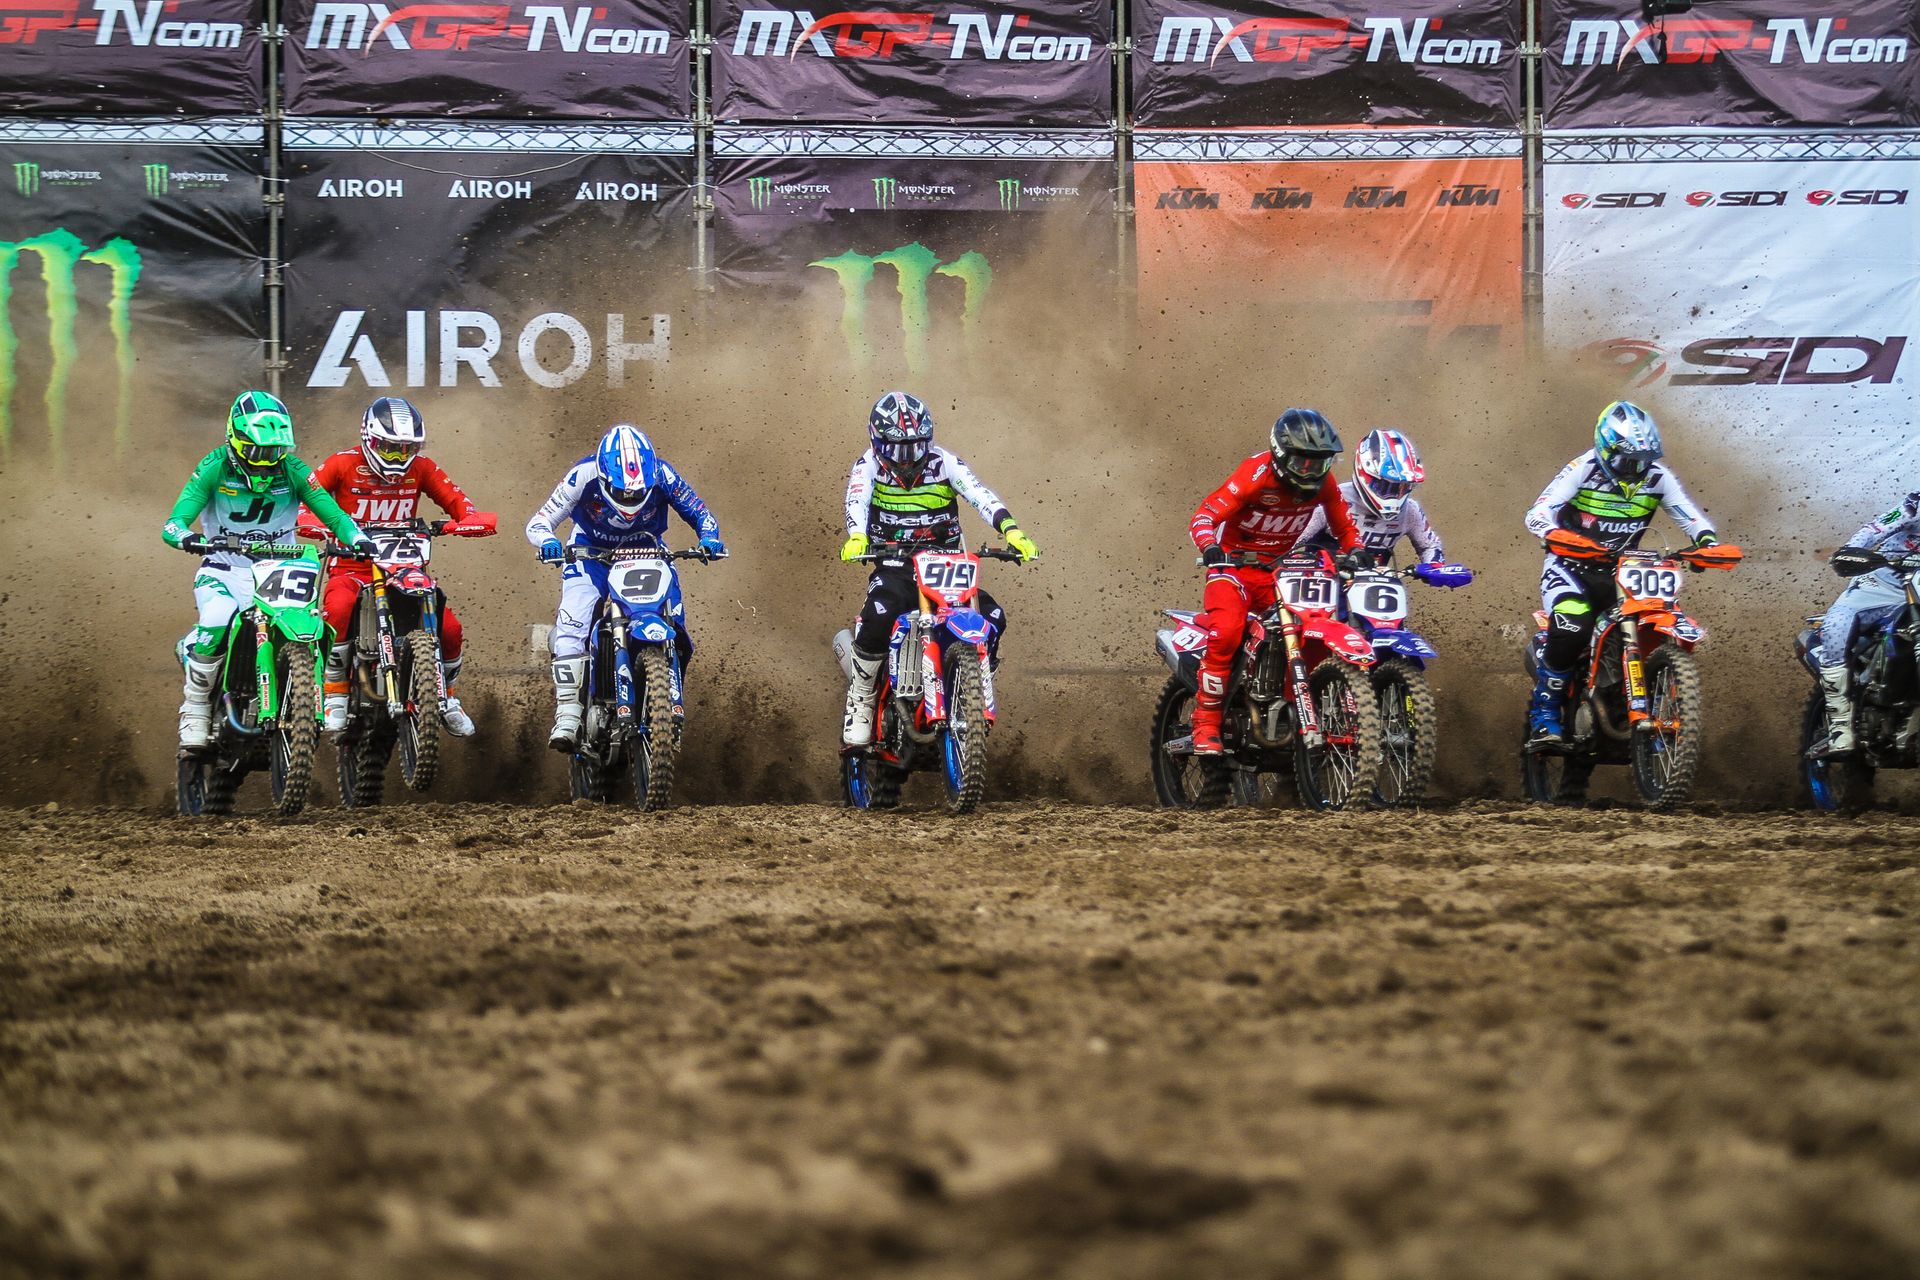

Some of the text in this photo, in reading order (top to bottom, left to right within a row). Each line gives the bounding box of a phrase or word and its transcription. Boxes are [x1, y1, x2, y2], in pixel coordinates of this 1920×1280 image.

[40, 170, 102, 181] MONSTER
[169, 171, 230, 182] MONSTER
[317, 179, 403, 198] AIROH
[448, 180, 532, 199] AIROH
[575, 182, 658, 201] AIROH
[774, 182, 831, 195] MONSTER
[898, 183, 956, 195] MONSTER
[1022, 185, 1080, 197] MONSTER
[1155, 186, 1220, 209] KTM
[1251, 186, 1313, 209] KTM
[1343, 185, 1407, 208] KTM
[1437, 184, 1500, 206] KTM
[1716, 191, 1788, 207] SIDI
[1837, 189, 1909, 205] SIDI
[1592, 192, 1667, 209] SIDI
[306, 310, 671, 388] AIROH
[1668, 336, 1907, 385] SIDI
[351, 499, 414, 521] JWR
[880, 511, 951, 527] Beta
[219, 525, 288, 542] Kwasaki
[1239, 511, 1310, 534] JWR
[1529, 519, 1550, 530] UFO
[1597, 521, 1645, 534] YUASA
[380, 538, 424, 560] 75
[256, 569, 316, 604] 43
[620, 569, 662, 598] 9
[924, 563, 976, 588] 919
[1626, 570, 1676, 597] 303
[1286, 578, 1332, 604] 161
[1364, 585, 1399, 613] 6
[1202, 671, 1224, 695] G
